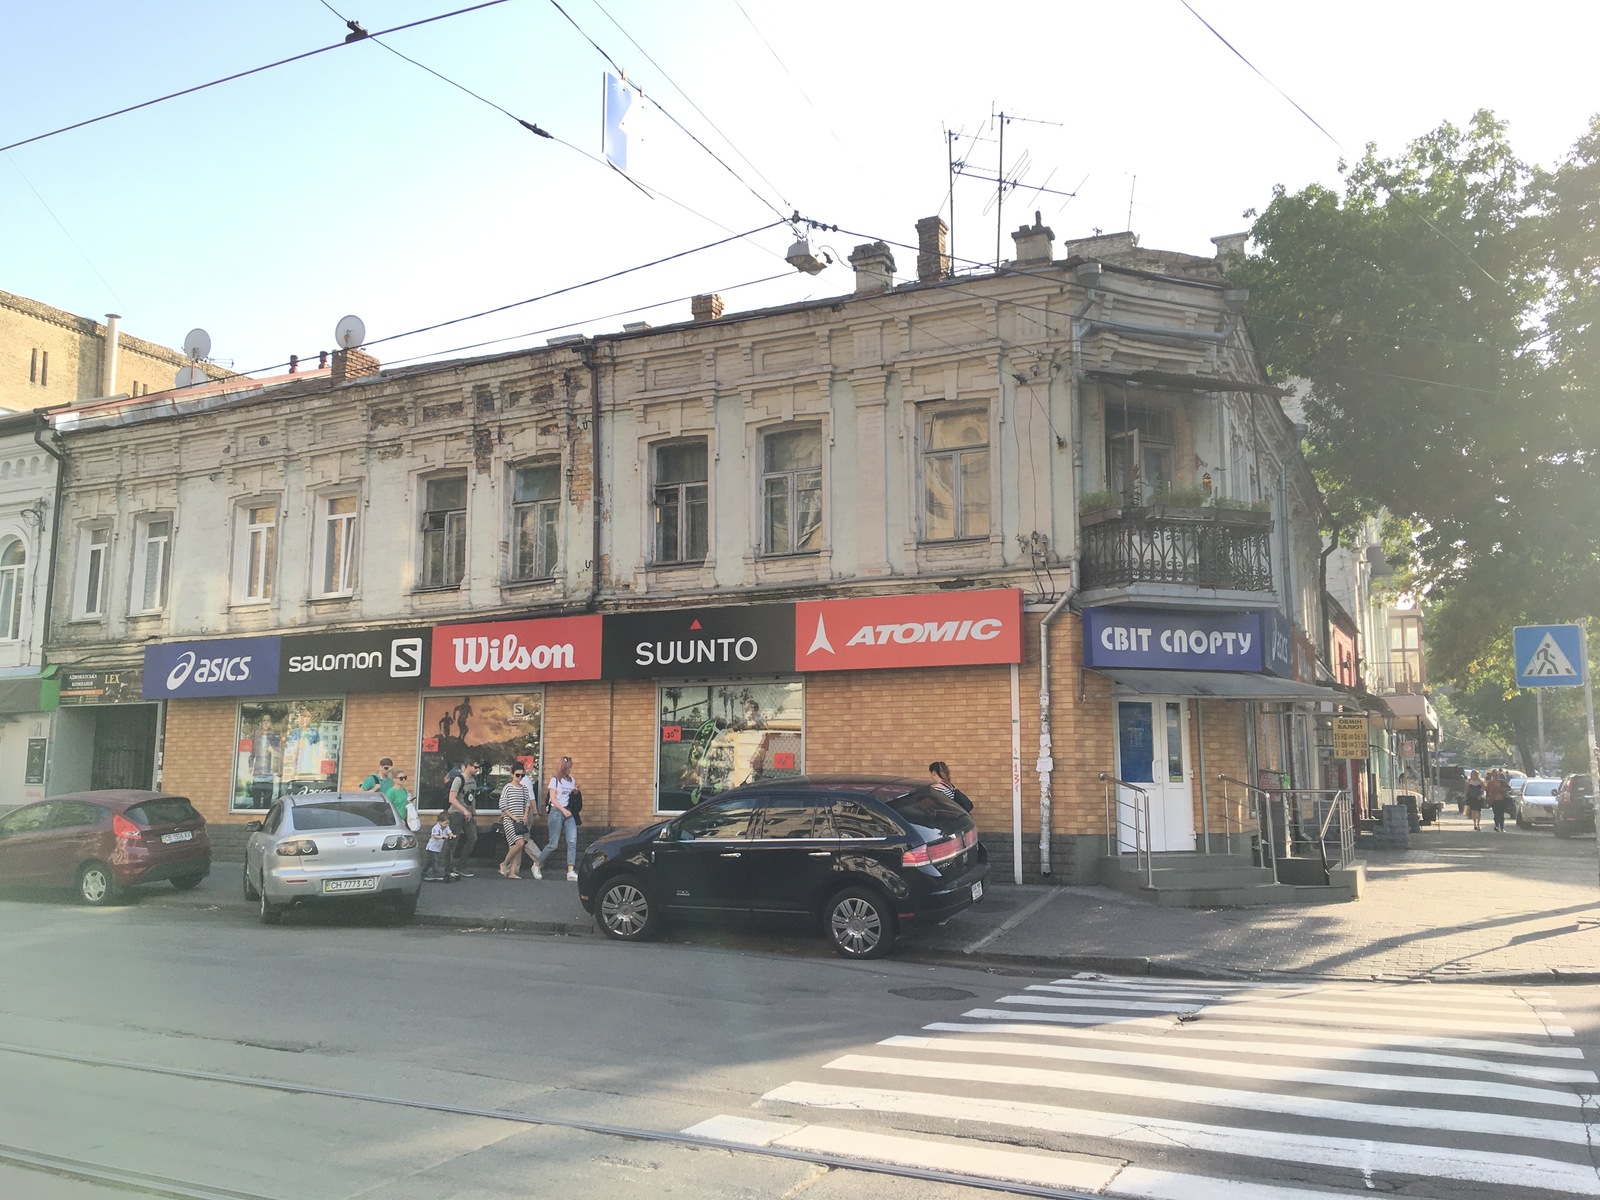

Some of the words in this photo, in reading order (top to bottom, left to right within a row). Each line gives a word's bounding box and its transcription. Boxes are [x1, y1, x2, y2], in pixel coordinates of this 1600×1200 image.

[846, 619, 1002, 646] ATOMIC
[1101, 627, 1151, 651] СВІТ
[1160, 629, 1251, 655] СПОРТУ
[453, 634, 576, 673] Wilson
[636, 637, 758, 666] SUUNTO
[105, 674, 120, 684] LEX
[344, 880, 360, 888] 7773
[363, 879, 373, 887] AC
